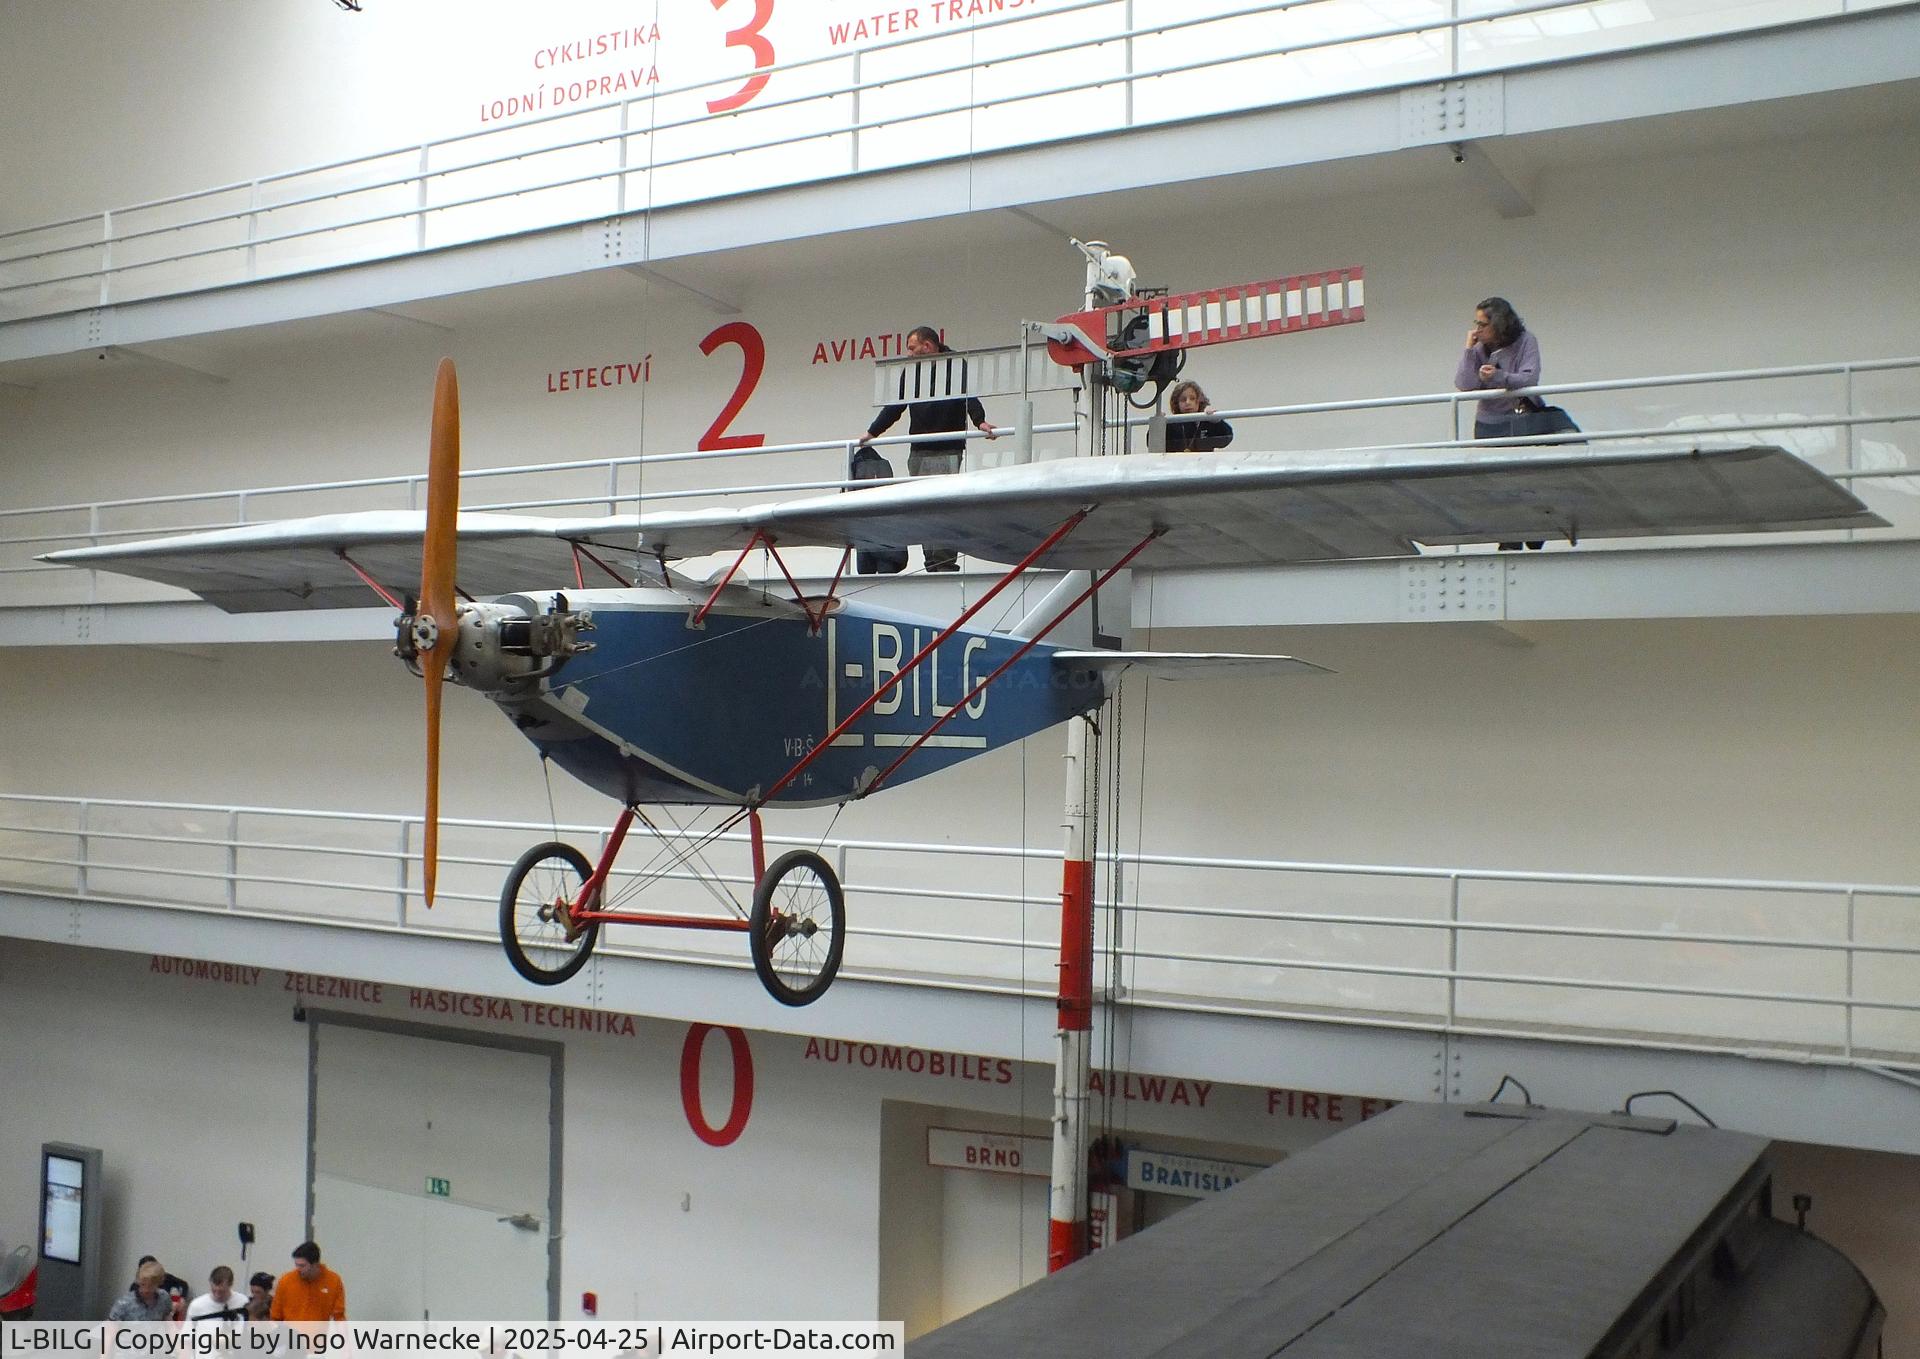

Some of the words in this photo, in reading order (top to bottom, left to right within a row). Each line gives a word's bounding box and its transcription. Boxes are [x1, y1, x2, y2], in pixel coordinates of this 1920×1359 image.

[534, 23, 661, 69] CYKLISTIKA
[829, 8, 919, 46] WATER
[931, 0, 1036, 24] TRAN
[706, 0, 776, 114] 3
[481, 84, 545, 122] LODNÍ
[553, 65, 660, 106] DOPRAVA
[812, 328, 945, 365] AVIATI
[548, 353, 652, 393] LETECTVÍ
[697, 321, 766, 452] 2
[827, 616, 988, 747] L-BILG
[151, 955, 262, 987] AUTOMOBILY
[521, 1003, 636, 1038] TECHNIKA
[804, 1036, 1014, 1085] AUTOMOBILES
[1088, 1071, 1213, 1107] AILWAY
[1266, 1088, 1344, 1122] FIRE
[965, 1146, 1021, 1168] BRNO
[1141, 1161, 1241, 1193] BRATISLA
